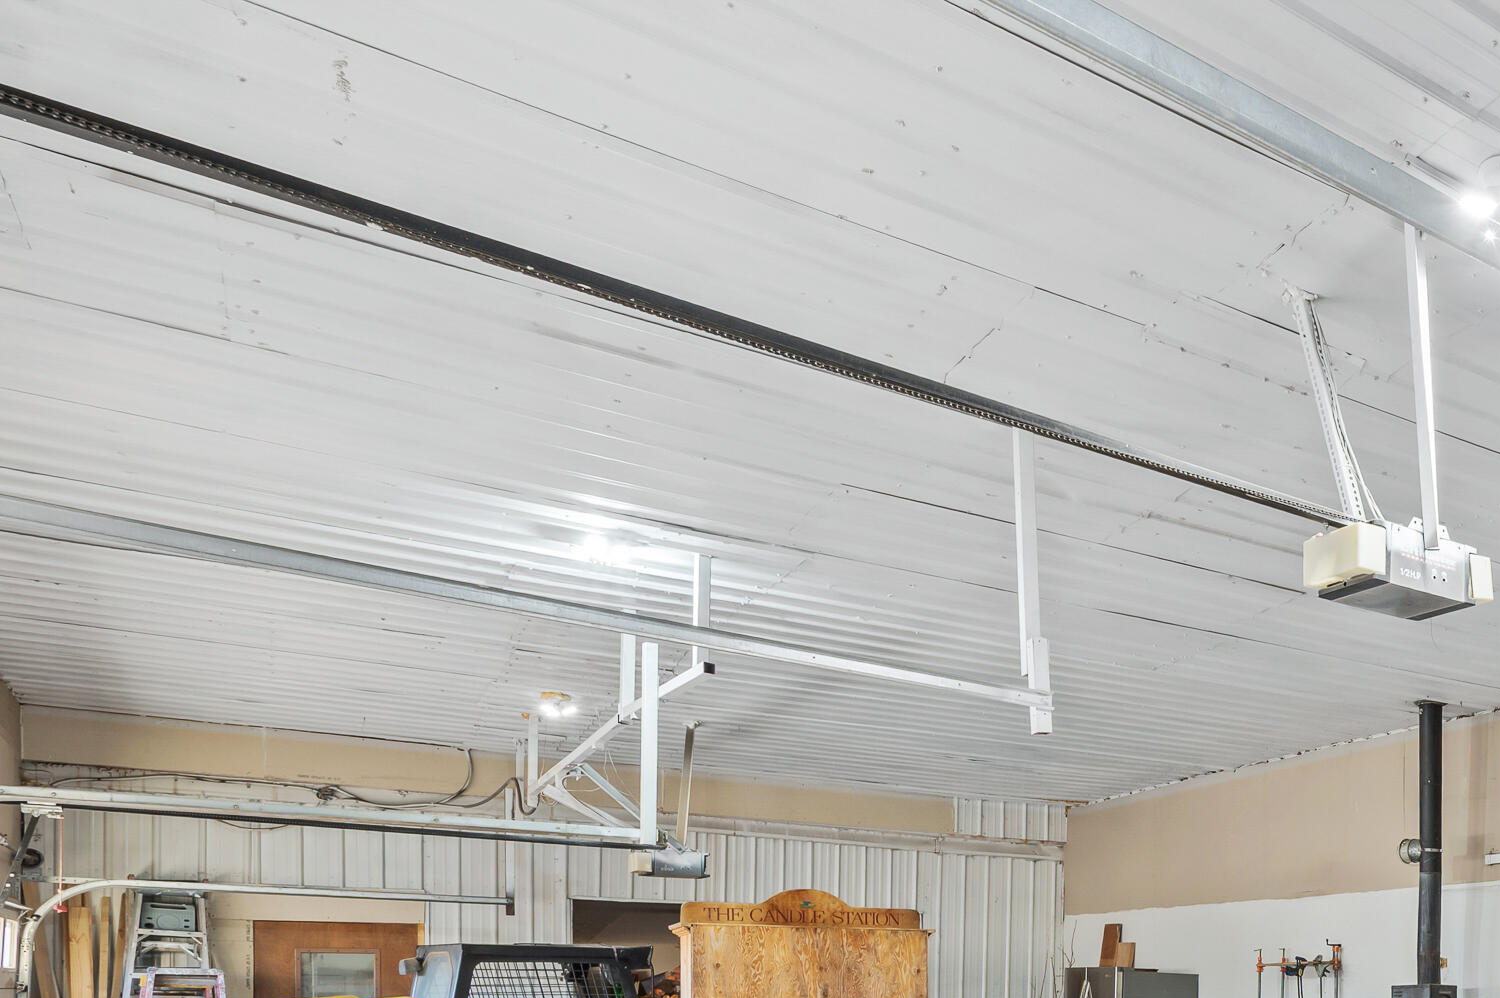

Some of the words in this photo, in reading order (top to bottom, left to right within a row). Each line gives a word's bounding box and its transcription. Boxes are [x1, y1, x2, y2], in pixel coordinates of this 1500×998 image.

[703, 907, 744, 922] THE
[750, 907, 825, 924] CANDLE
[831, 911, 900, 926] STATION
